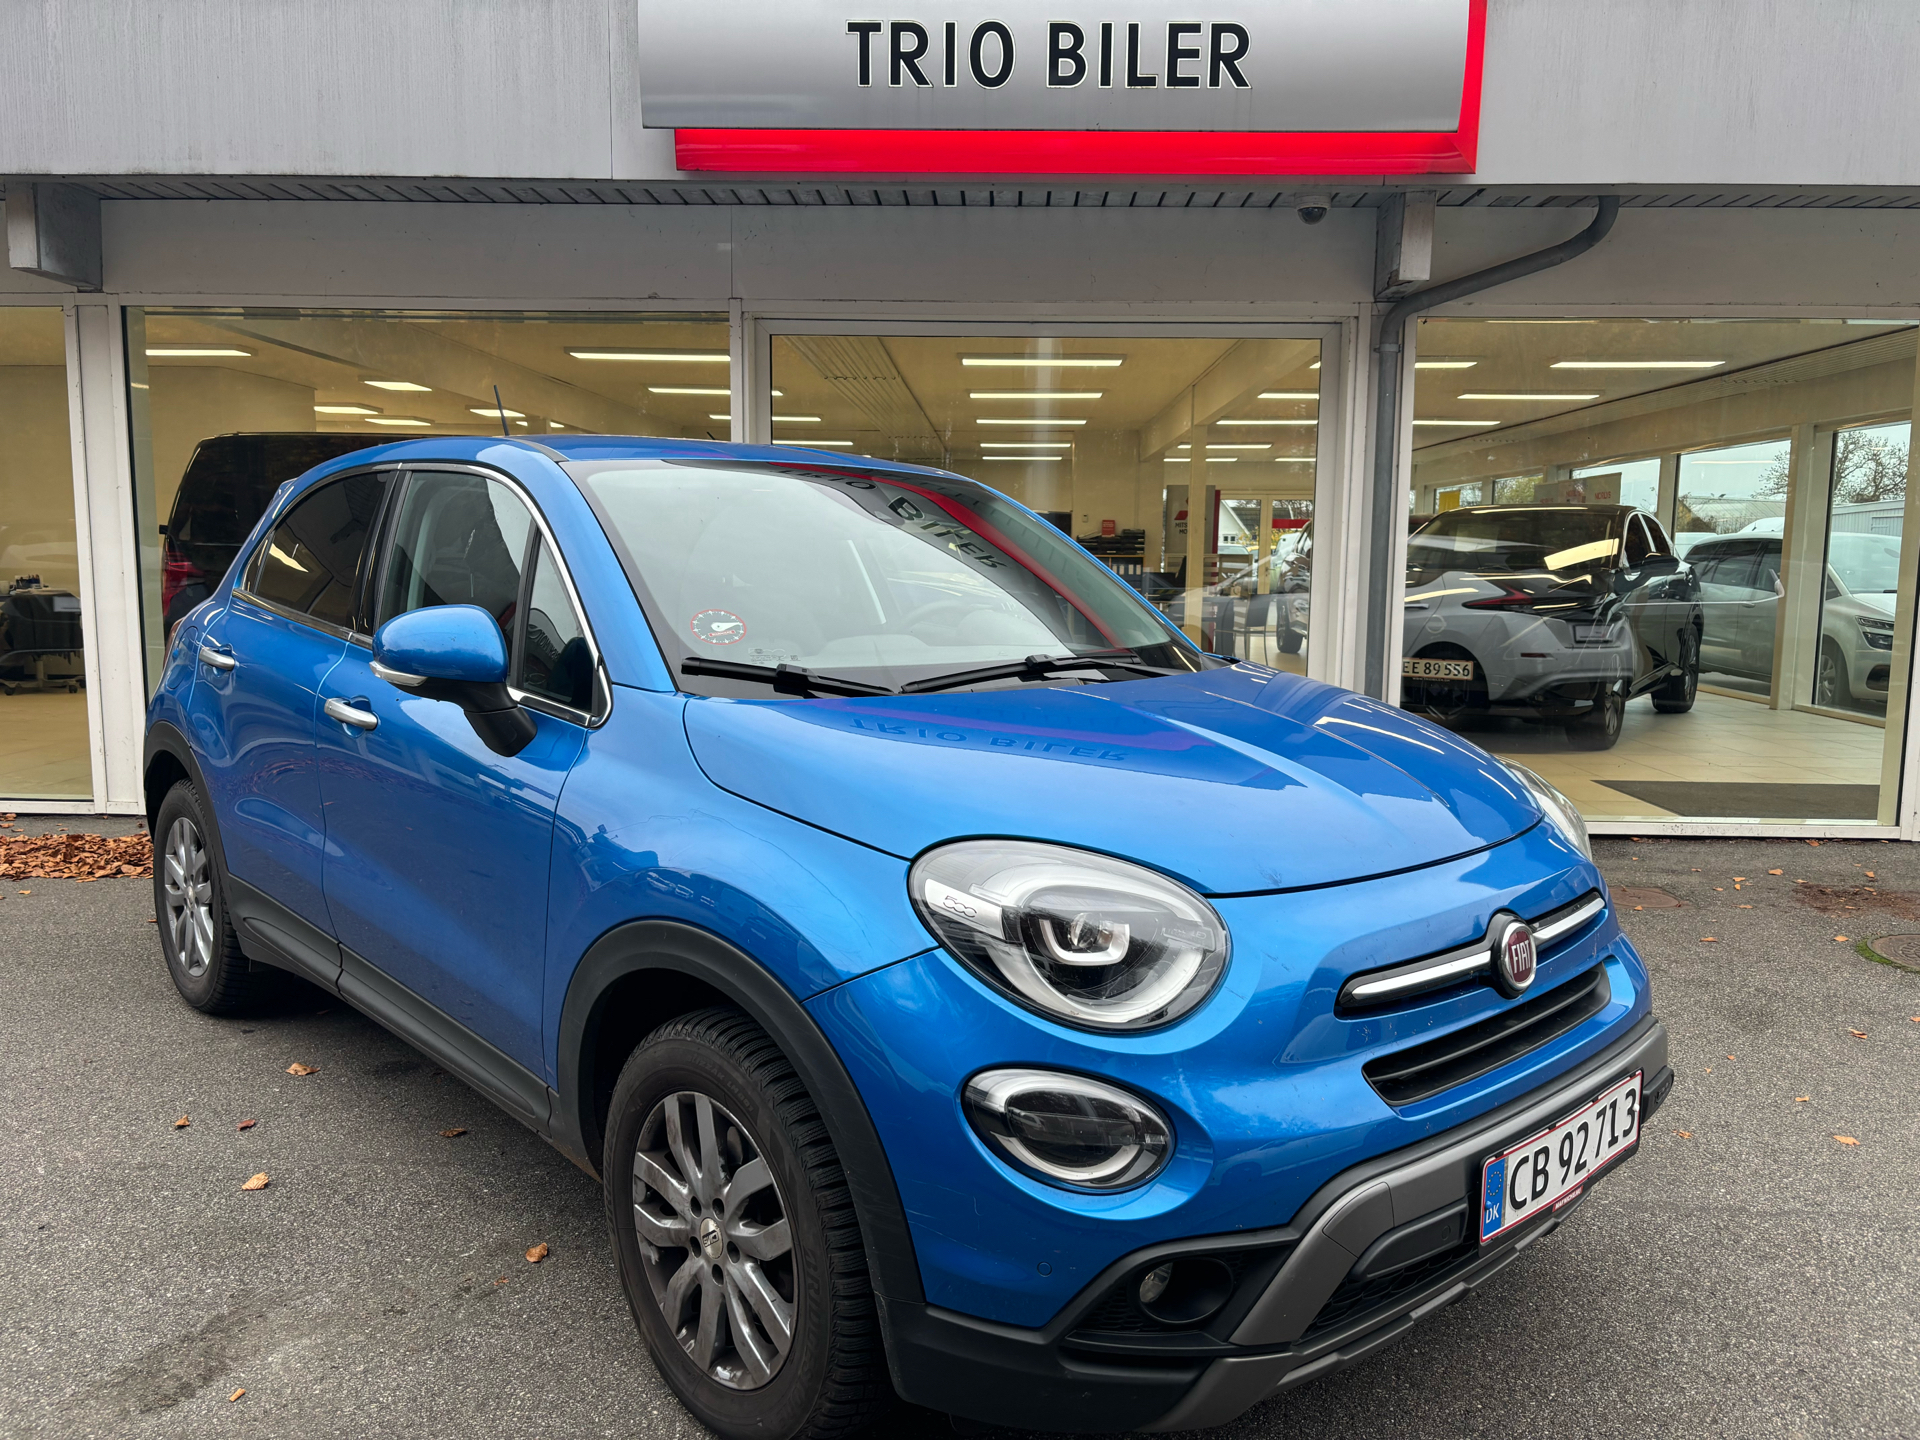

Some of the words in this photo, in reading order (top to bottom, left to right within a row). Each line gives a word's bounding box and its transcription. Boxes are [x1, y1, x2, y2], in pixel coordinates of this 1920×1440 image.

[846, 20, 1016, 89] TRIO
[1047, 21, 1252, 90] BILER
[1423, 662, 1441, 676] 89
[1443, 663, 1470, 677] 556
[943, 895, 977, 918] 500
[1511, 940, 1530, 974] FIAT
[1509, 1145, 1550, 1211] CB
[1559, 1121, 1589, 1186] 92
[1595, 1087, 1637, 1160] 713
[1485, 1203, 1500, 1224] DK
